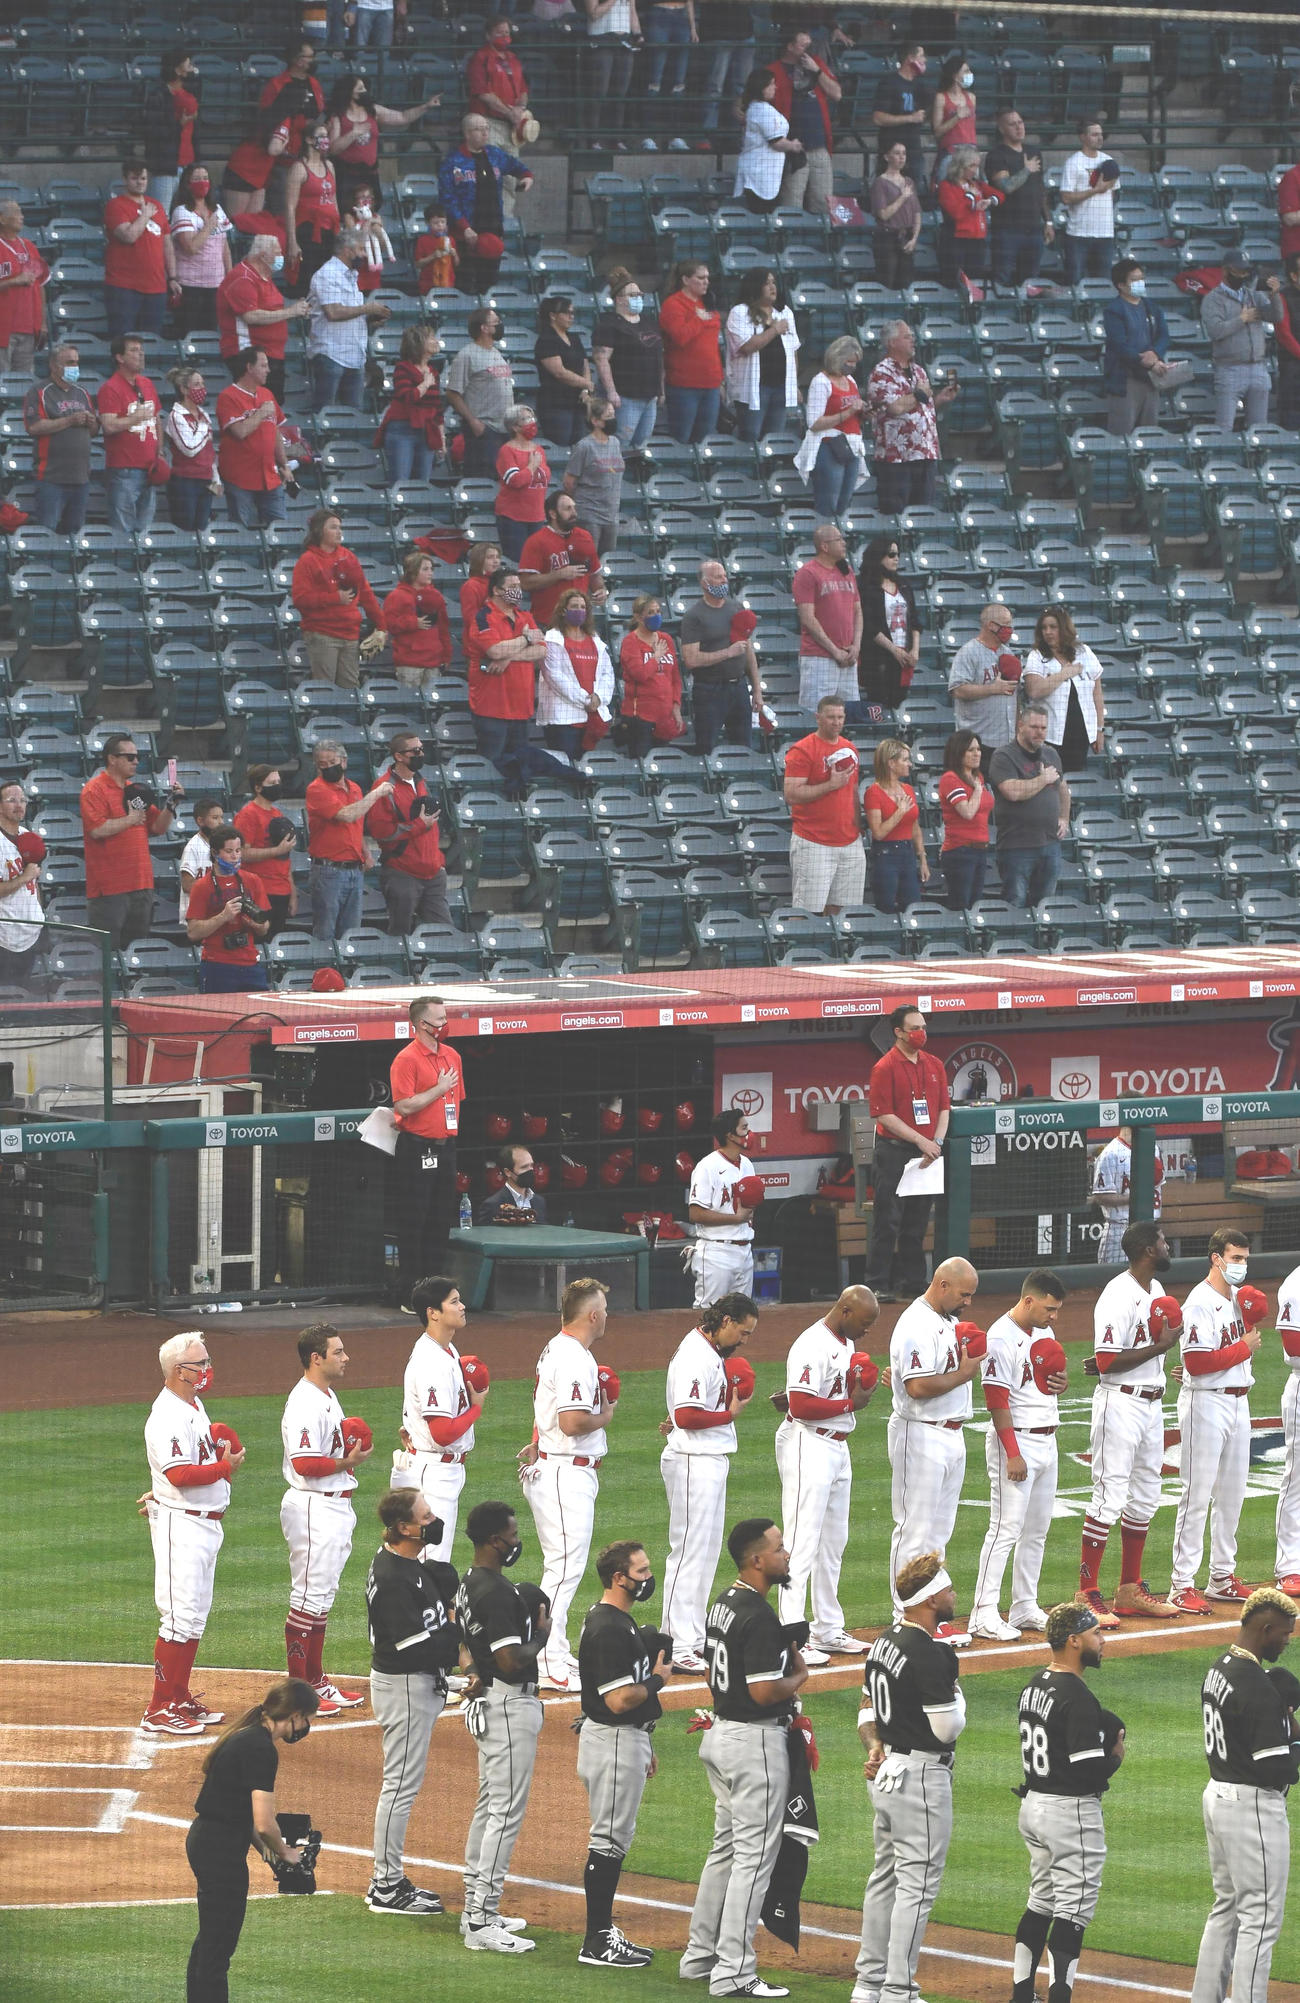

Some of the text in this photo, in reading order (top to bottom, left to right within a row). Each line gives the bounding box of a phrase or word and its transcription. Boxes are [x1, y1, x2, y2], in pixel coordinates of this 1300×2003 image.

[1187, 987, 1218, 996] TOYOTA
[1265, 983, 1296, 992] TOYOTA
[934, 998, 966, 1008] TOYOTA
[1014, 994, 1046, 1004] TOYOTA
[1080, 990, 1134, 1003] angels.com
[758, 1007, 790, 1017] TOYOTA
[824, 1003, 880, 1015] angels.com
[564, 1016, 620, 1028] angels.com
[676, 1011, 708, 1021] TOYOTA
[495, 1020, 528, 1030] TOYOTA
[297, 1028, 355, 1040] angels.com
[952, 1047, 1003, 1070] ANGELS
[1111, 1066, 1226, 1096] TOYOTA
[1001, 1082, 1012, 1095] 61
[784, 1084, 870, 1113] TOYO
[1122, 1106, 1168, 1120] TOYOTA
[1225, 1101, 1271, 1114] TOYOTA
[1019, 1112, 1065, 1126] TOYOTA
[26, 1131, 76, 1145] TOYOTA
[230, 1126, 278, 1139] TOYOTA
[1003, 1130, 1084, 1152] TOYOTA
[423, 1600, 447, 1631] 22
[633, 1656, 651, 1684] 12
[706, 1638, 730, 1694] 79
[869, 1669, 891, 1726] 10
[1203, 1701, 1228, 1761] 88
[1019, 1719, 1051, 1778] 28
